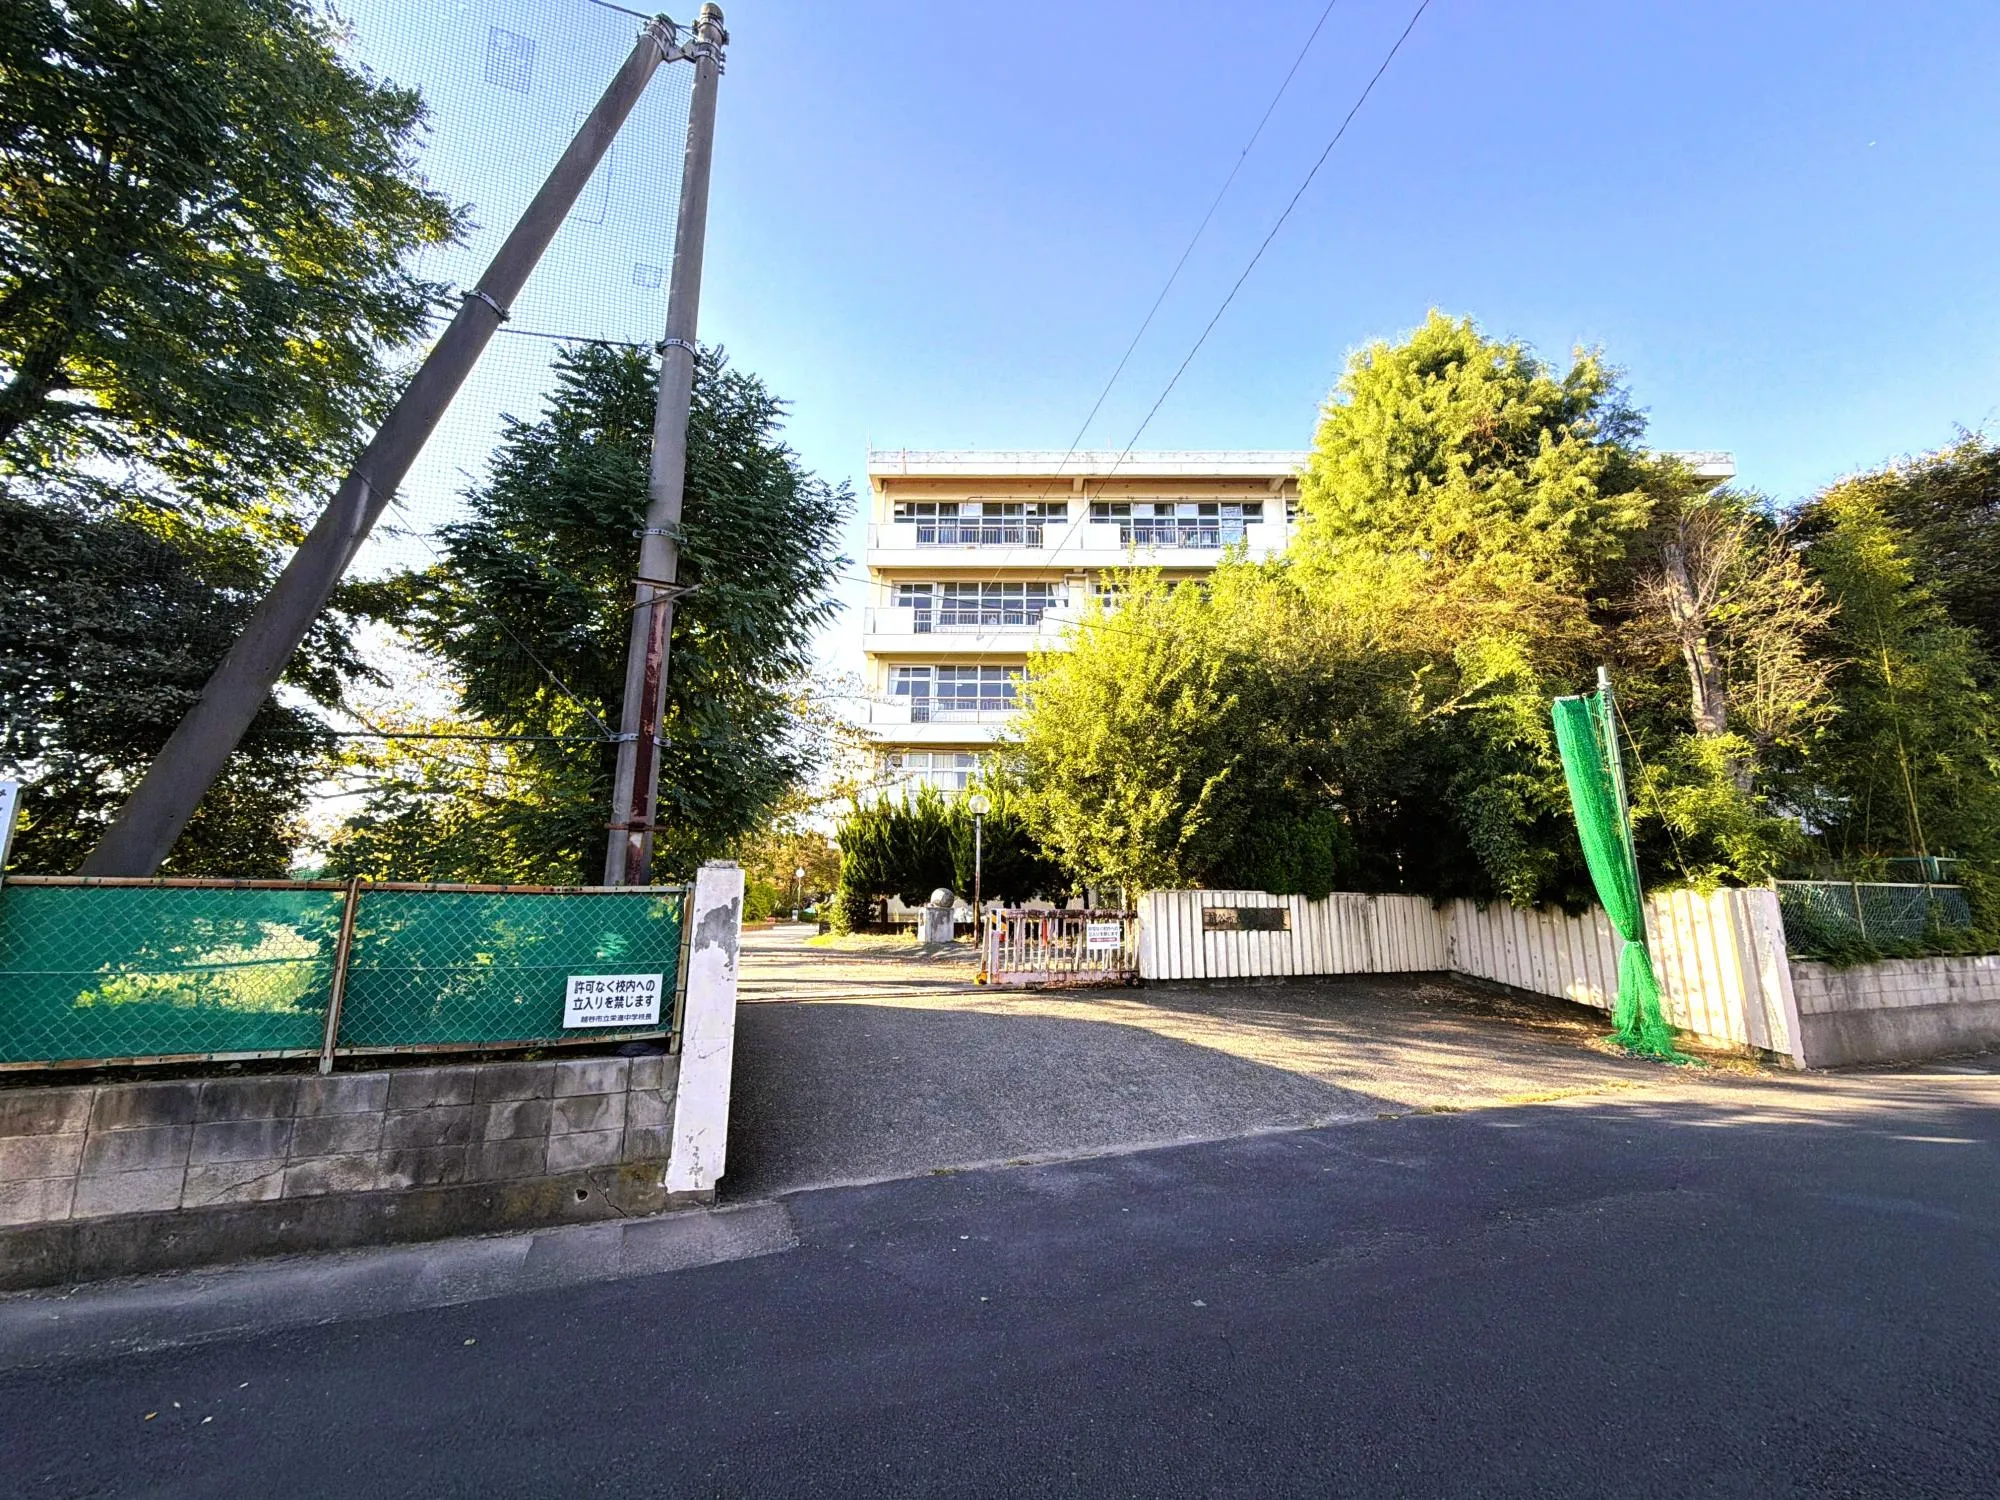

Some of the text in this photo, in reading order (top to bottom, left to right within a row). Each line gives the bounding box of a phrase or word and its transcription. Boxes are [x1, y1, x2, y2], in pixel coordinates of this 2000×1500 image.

[574, 979, 655, 994] 許可なく校内への
[572, 994, 654, 1011] 立入りを禁じます
